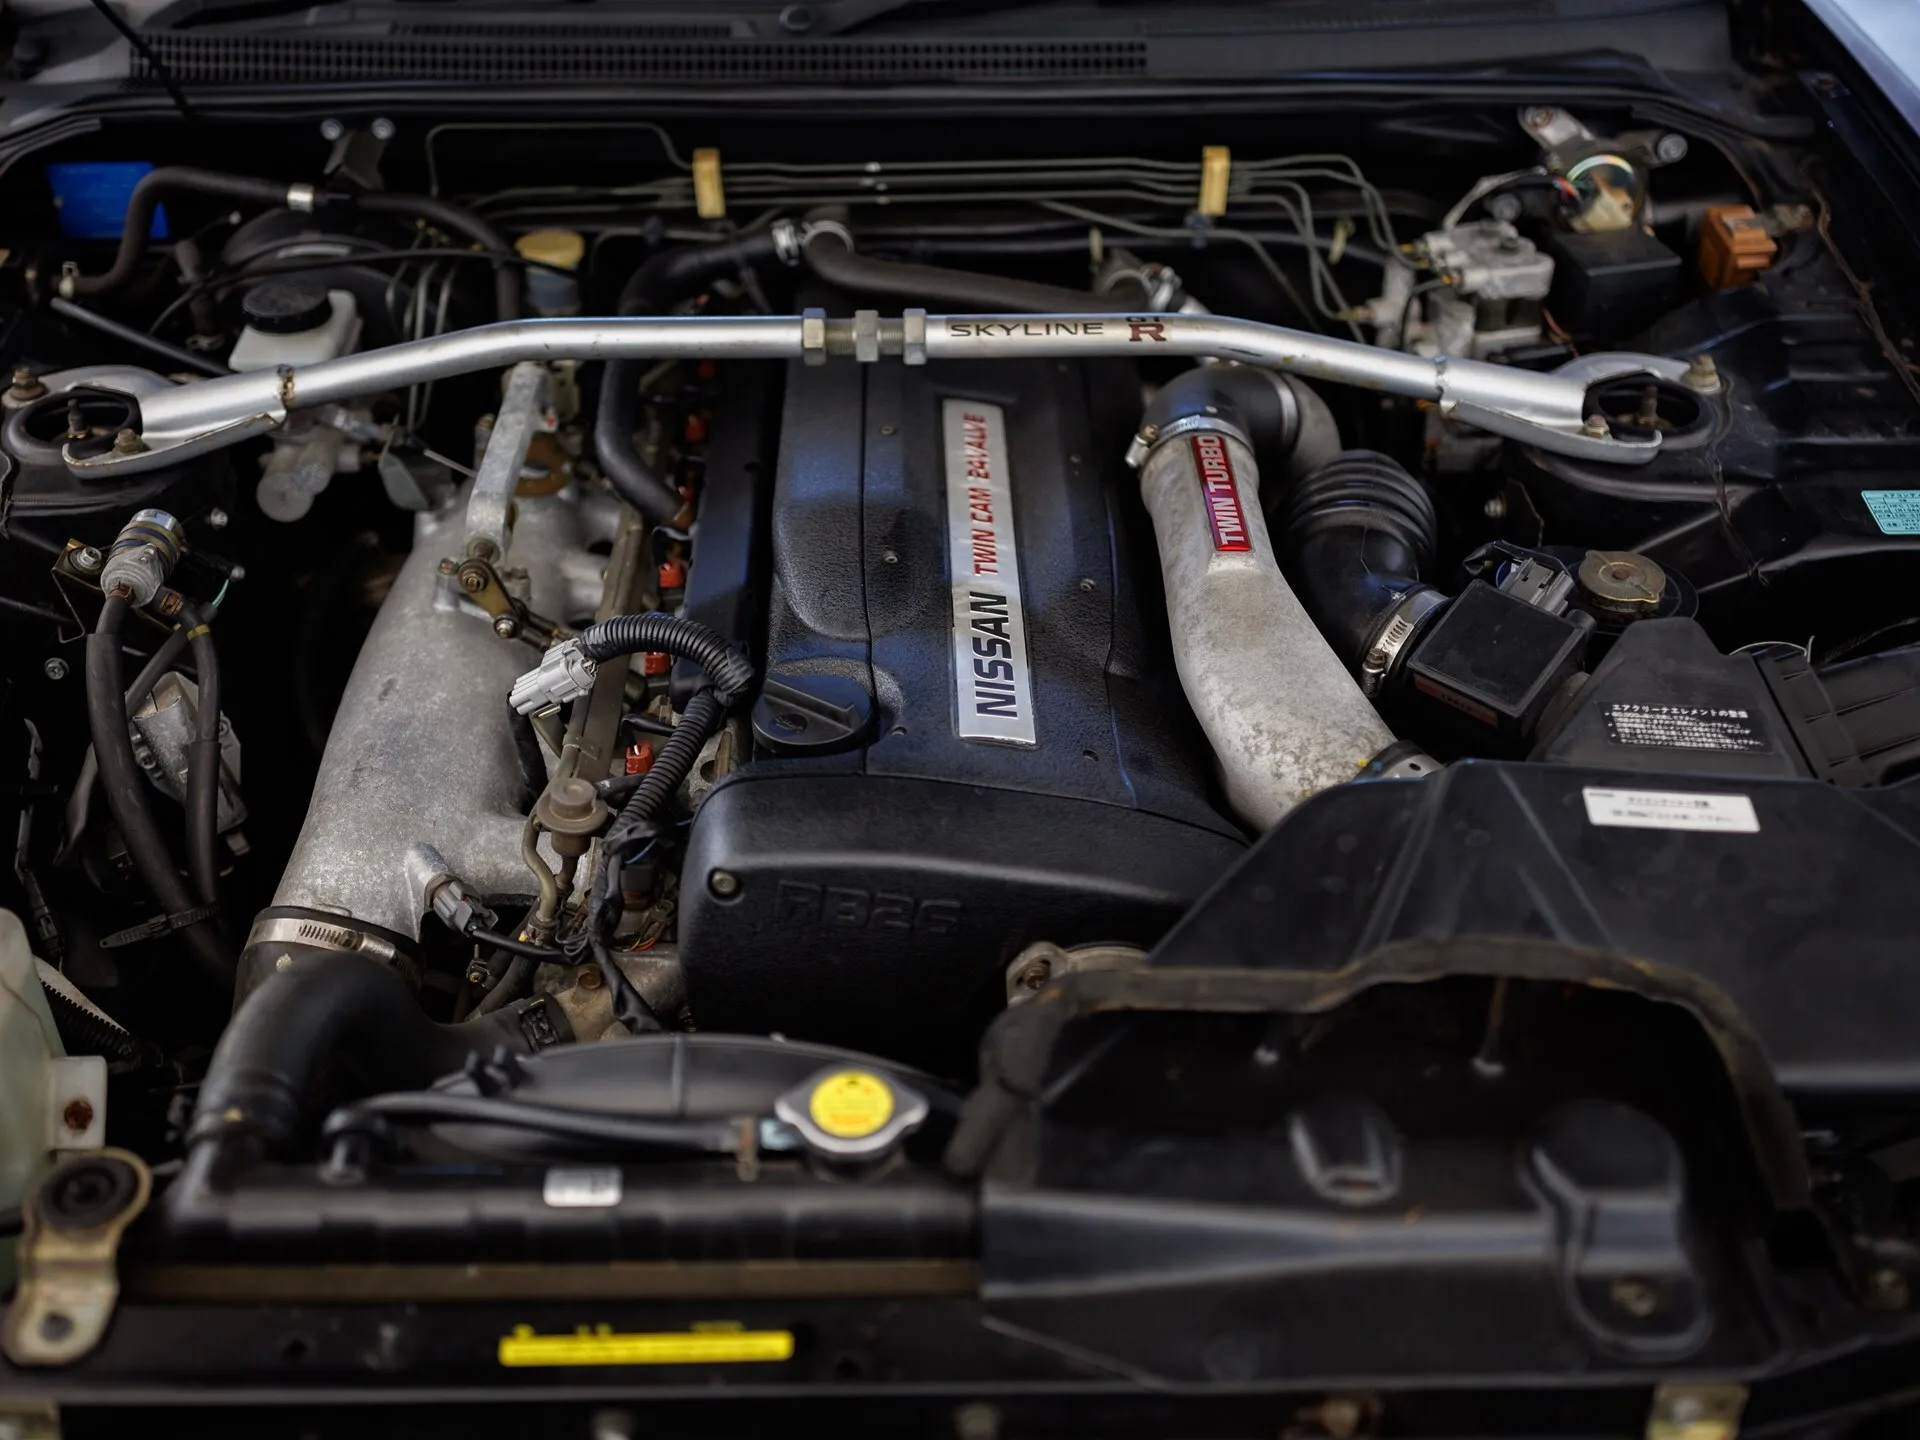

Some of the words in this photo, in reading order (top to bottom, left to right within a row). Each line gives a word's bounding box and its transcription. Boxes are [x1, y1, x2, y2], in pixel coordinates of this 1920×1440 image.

[950, 322, 1104, 337] SKYLINE
[962, 412, 991, 480] 24VALVE
[1198, 436, 1233, 493] TURBO
[967, 487, 993, 524] CAM
[1211, 497, 1245, 545] TWIN
[973, 528, 998, 576] TWIN
[969, 590, 1018, 720] NISSAN
